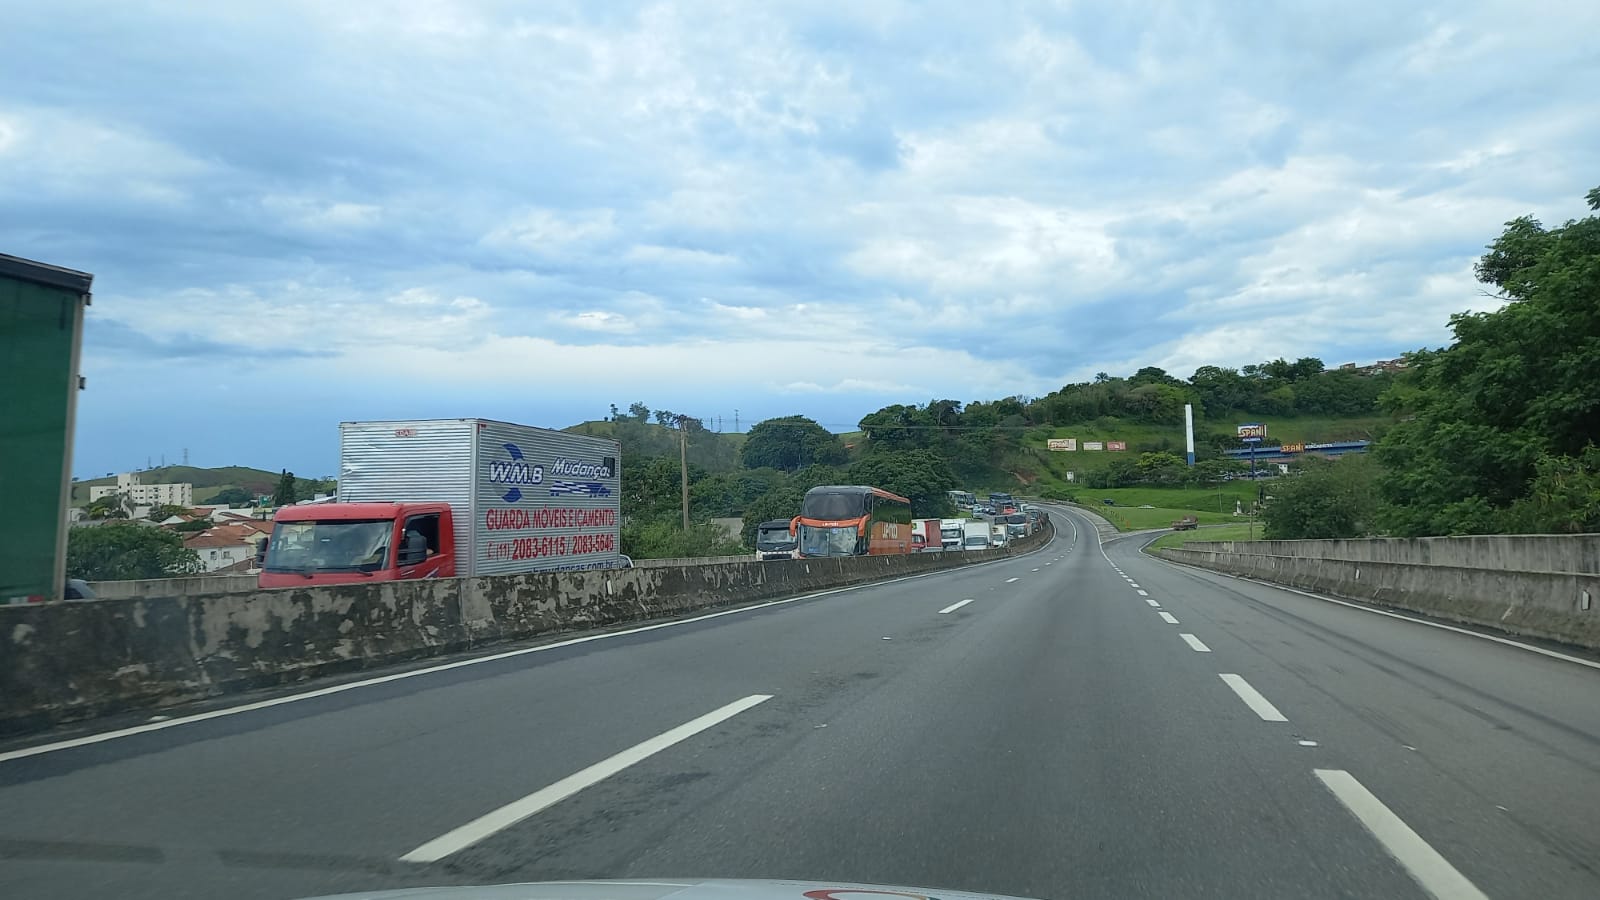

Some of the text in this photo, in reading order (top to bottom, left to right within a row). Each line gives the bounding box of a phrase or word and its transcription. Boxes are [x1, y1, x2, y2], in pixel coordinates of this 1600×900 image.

[486, 504, 615, 532] GUARDA MÓVEIS E IÇAMENTO
[512, 537, 566, 560] 2083-6115
